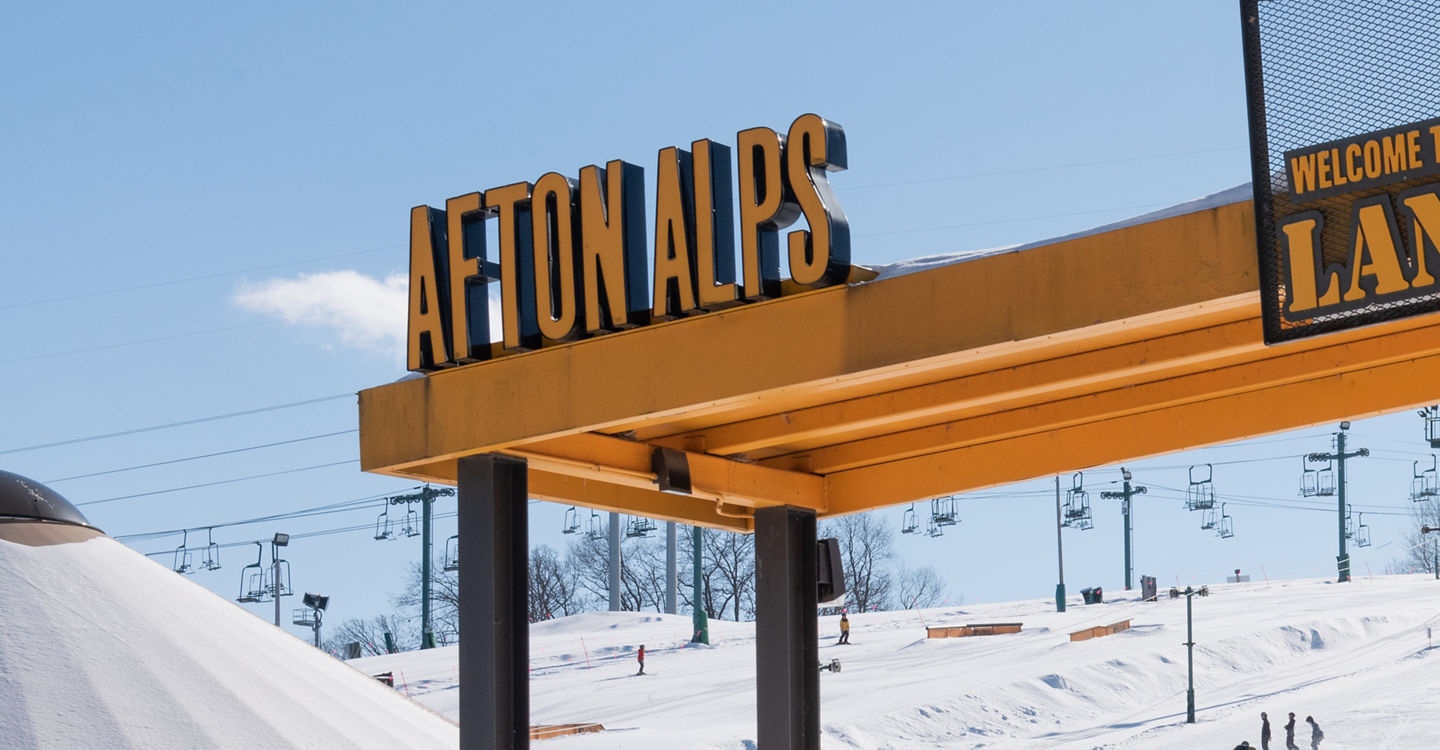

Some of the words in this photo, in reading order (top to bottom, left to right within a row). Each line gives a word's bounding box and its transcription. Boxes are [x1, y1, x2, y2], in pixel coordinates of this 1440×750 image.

[407, 159, 633, 371] AFTON
[653, 113, 840, 317] ALPS
[1291, 130, 1423, 194] WELCOME
